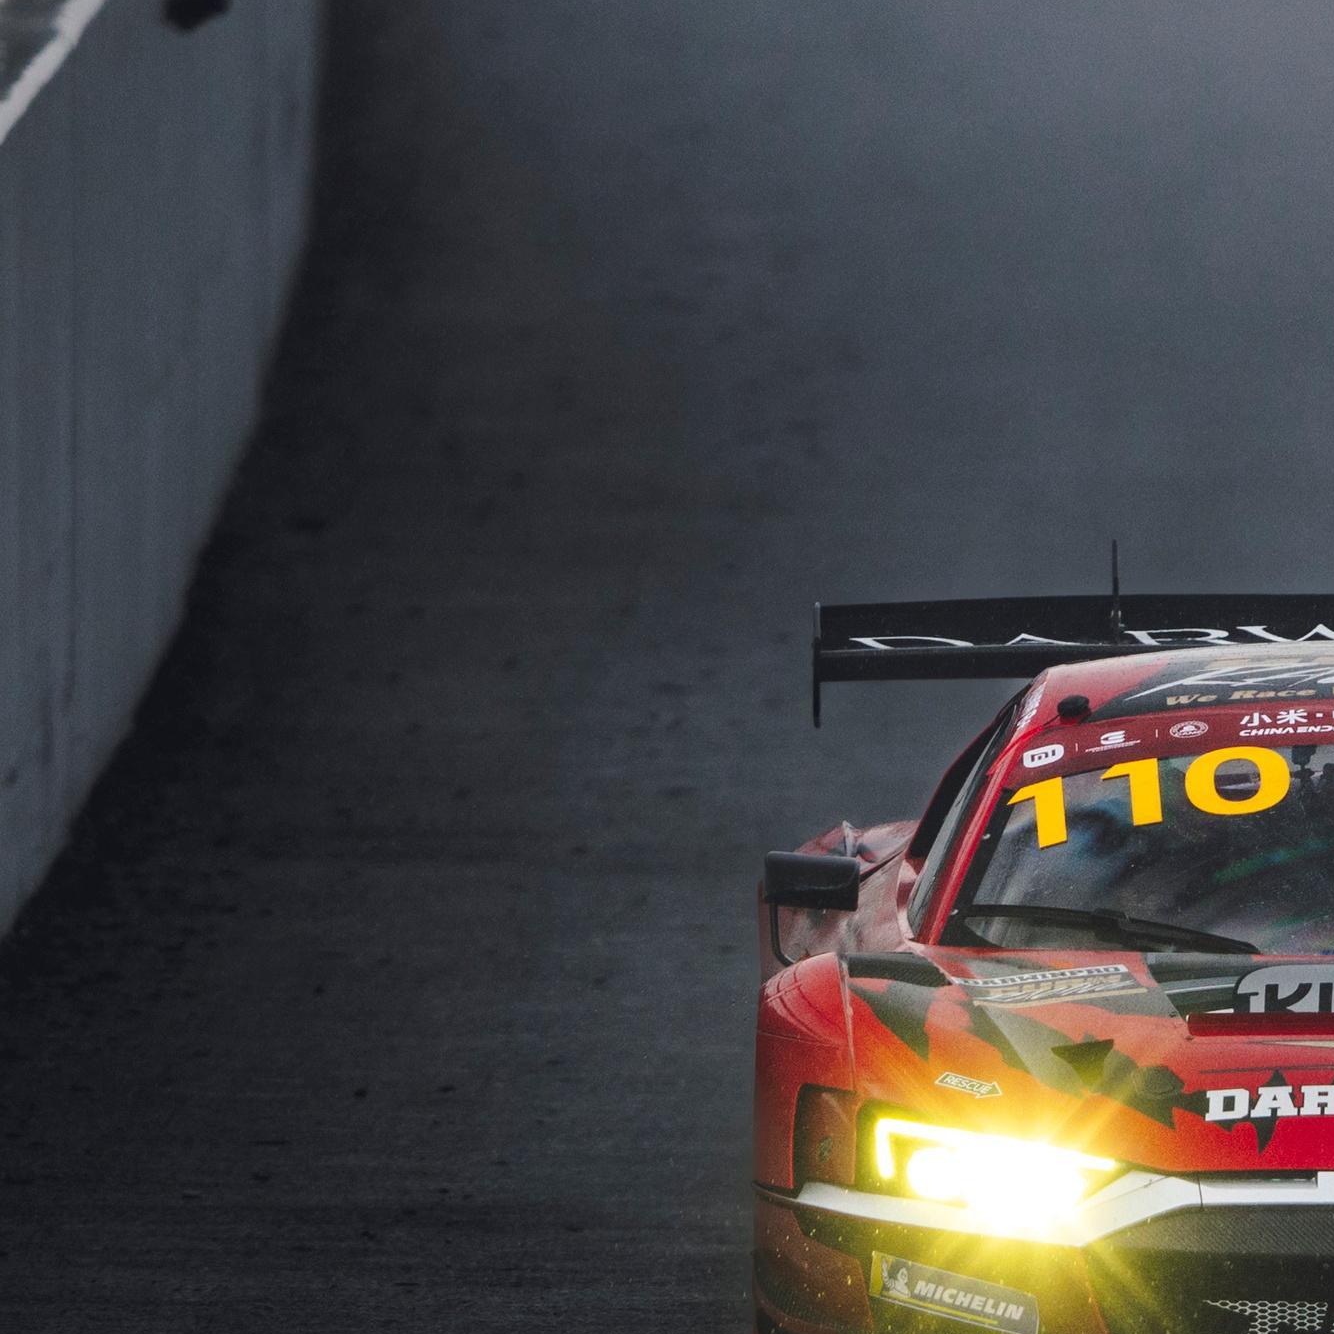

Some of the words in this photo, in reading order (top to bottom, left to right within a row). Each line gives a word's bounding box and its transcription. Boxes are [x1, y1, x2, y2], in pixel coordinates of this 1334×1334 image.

[1166, 693, 1218, 705] We
[1229, 688, 1316, 700] Race
[1239, 726, 1295, 737] CHINA
[1007, 746, 1291, 850] 110
[943, 1071, 993, 1095] RESCUE
[913, 1280, 1025, 1320] MICHELIN
